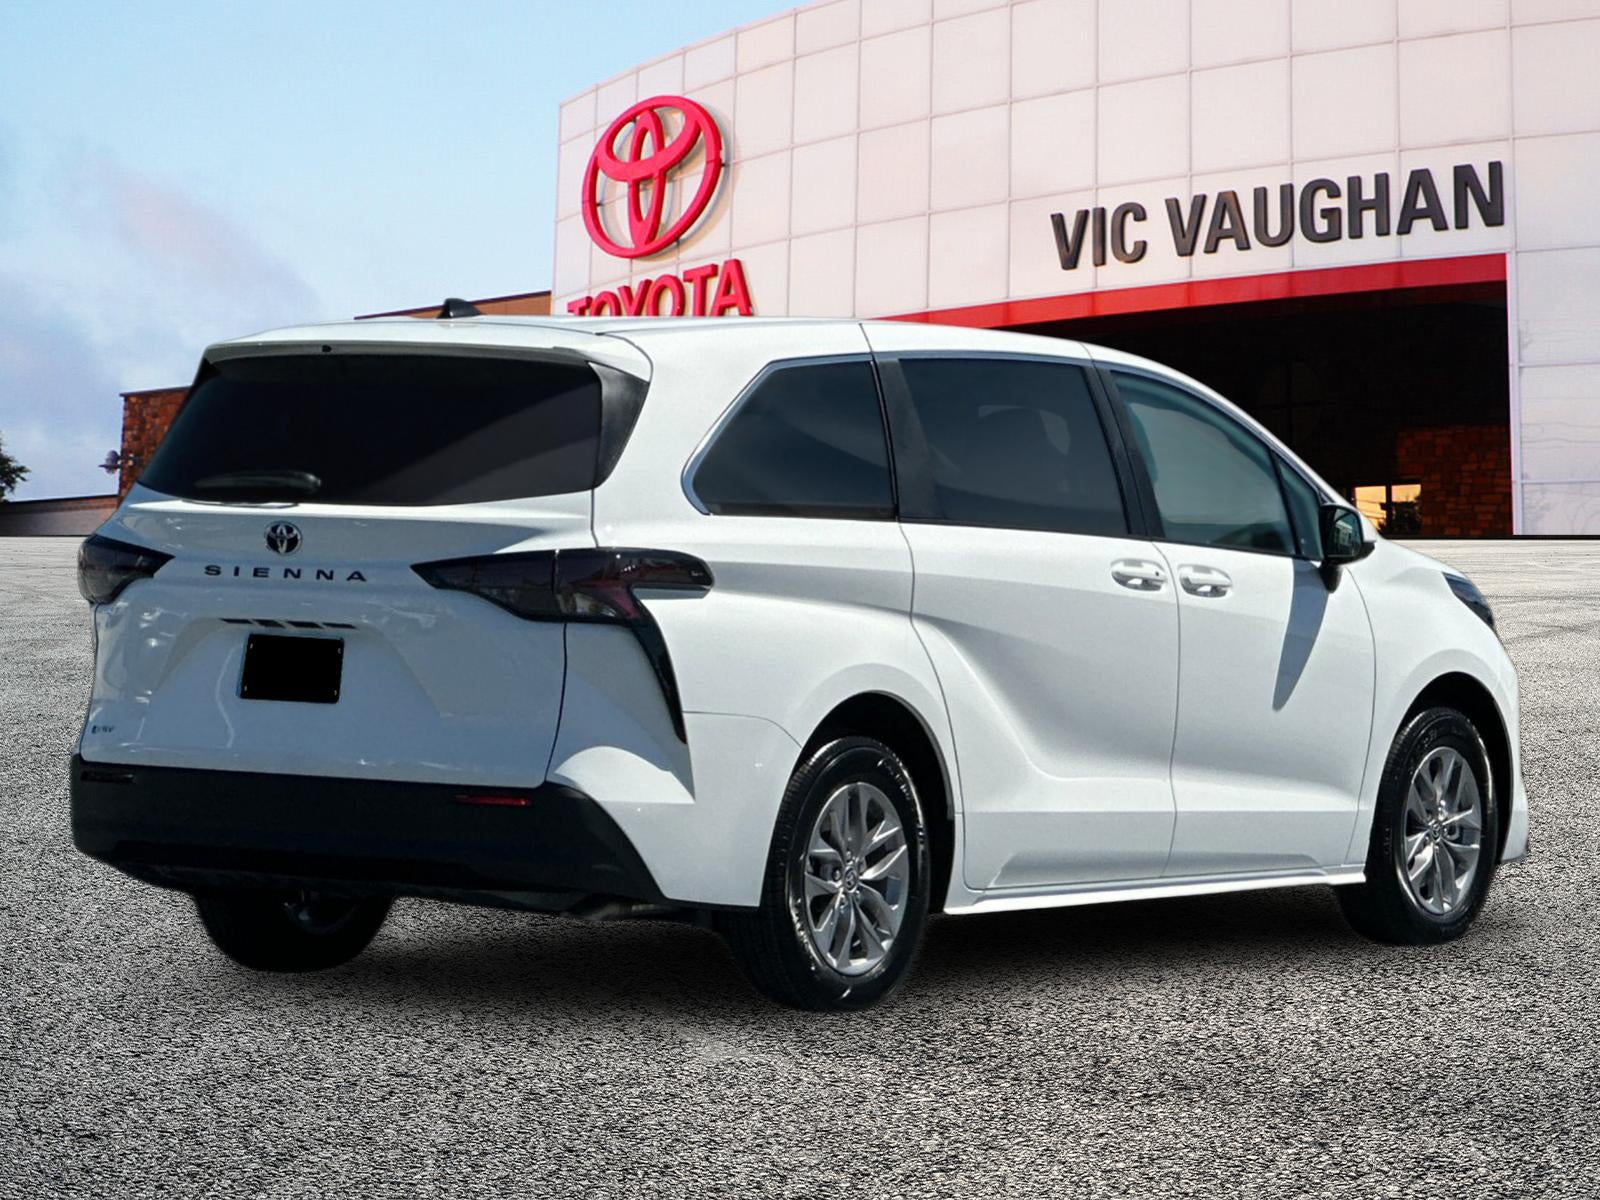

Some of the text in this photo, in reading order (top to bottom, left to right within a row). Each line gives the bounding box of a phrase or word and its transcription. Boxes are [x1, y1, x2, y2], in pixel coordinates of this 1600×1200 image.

[1050, 160, 1505, 271] VIC VAUGHAN
[567, 258, 754, 317] TOYOTA
[204, 564, 367, 582] SIENNA
